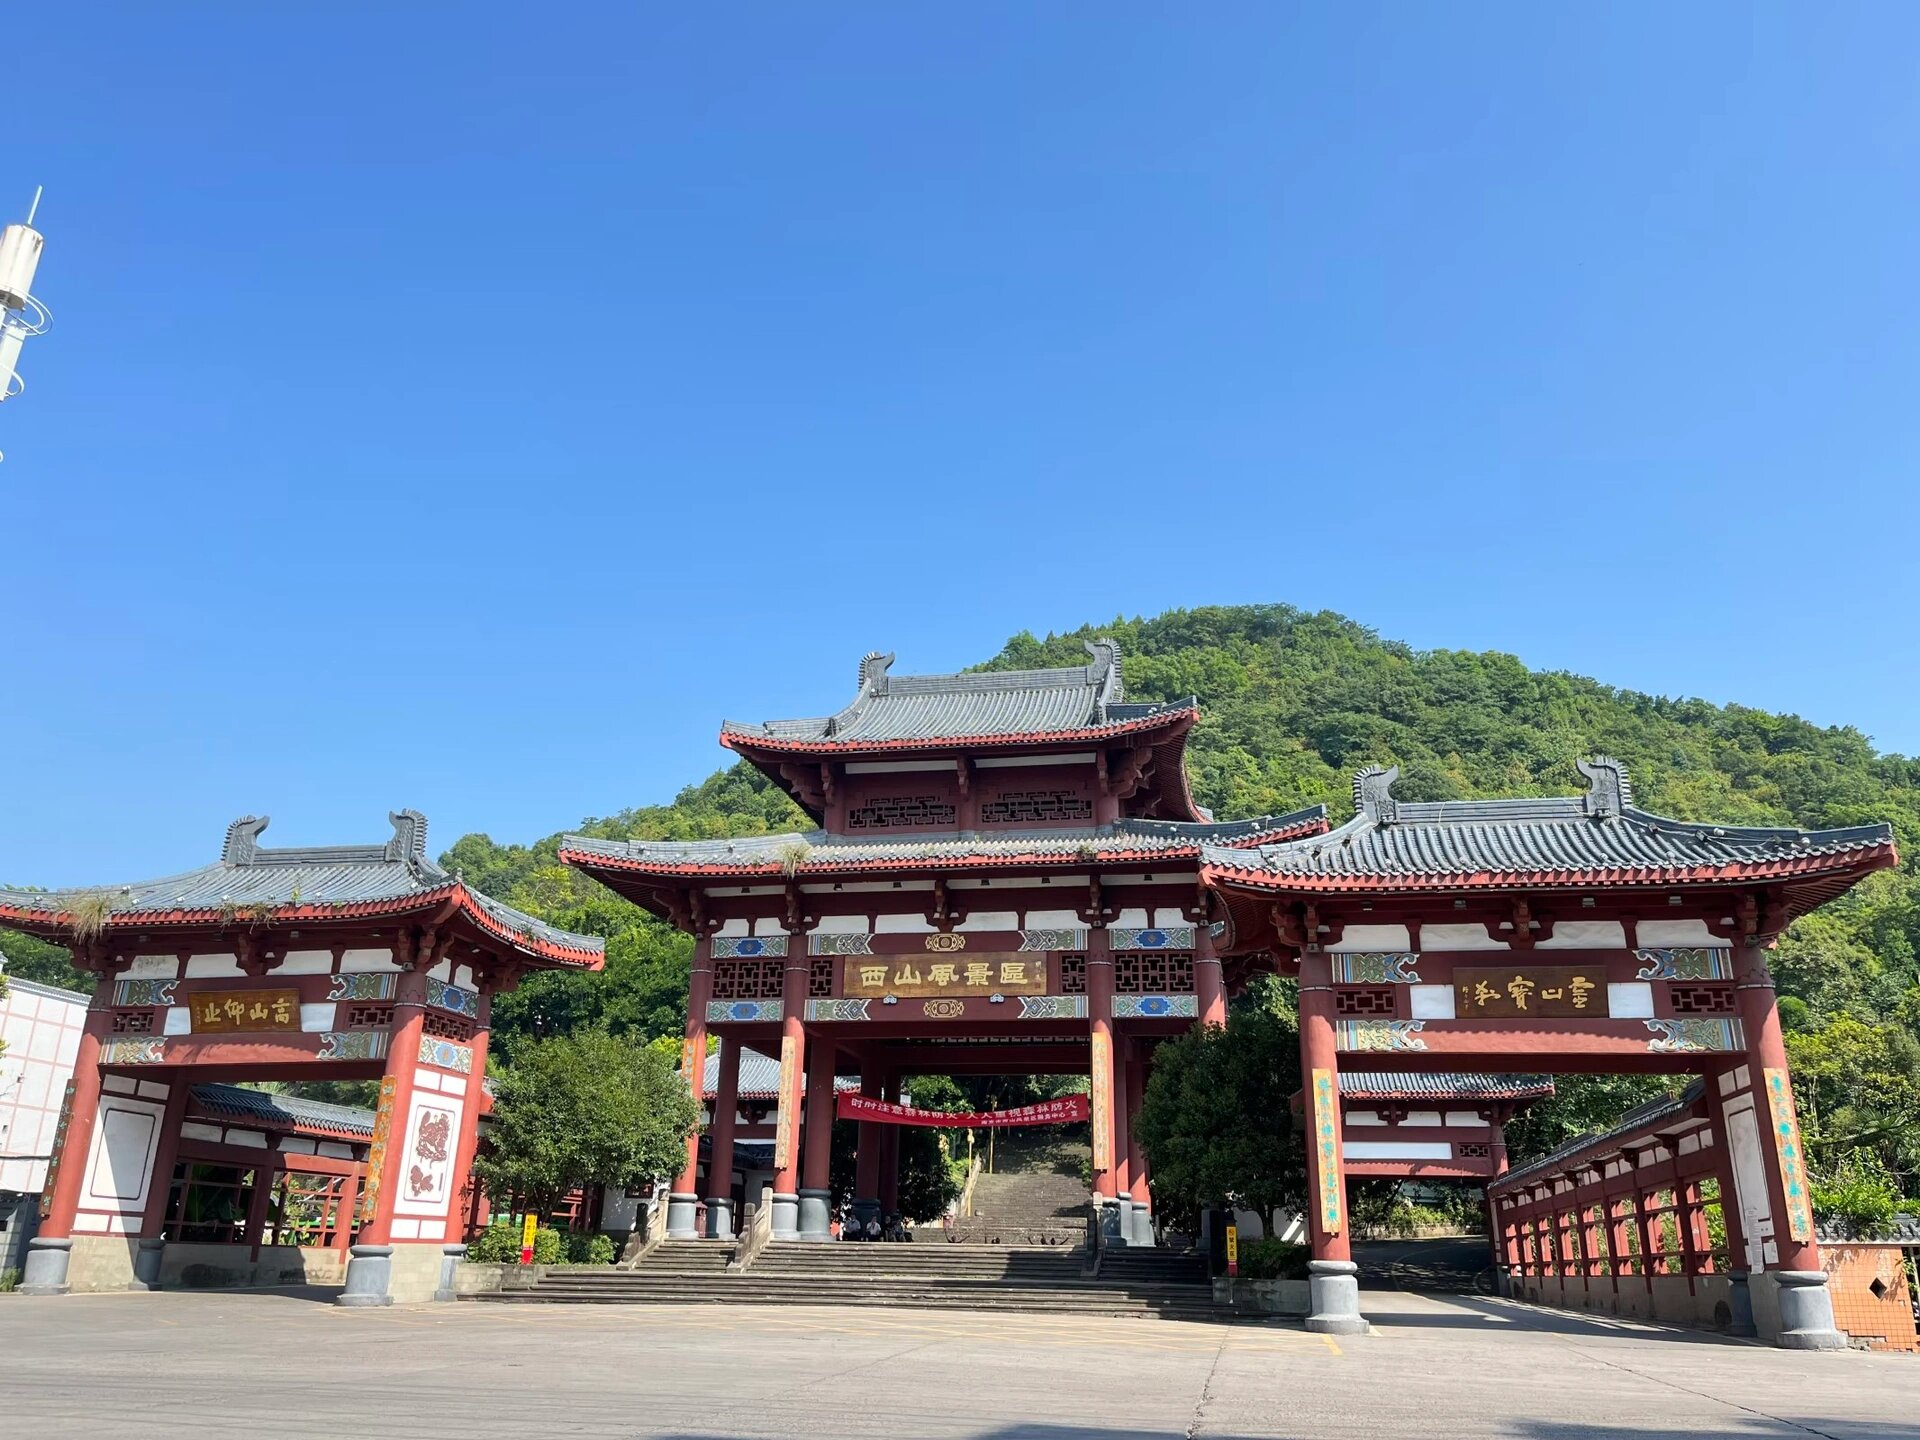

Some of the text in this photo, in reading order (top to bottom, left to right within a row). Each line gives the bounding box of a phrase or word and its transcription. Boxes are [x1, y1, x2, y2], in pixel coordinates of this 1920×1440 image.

[860, 962, 1028, 987] 西山風景區
[204, 997, 290, 1025] 高山仰止
[851, 1098, 1078, 1120] 时时注意森林防火 人人重视森林防火
